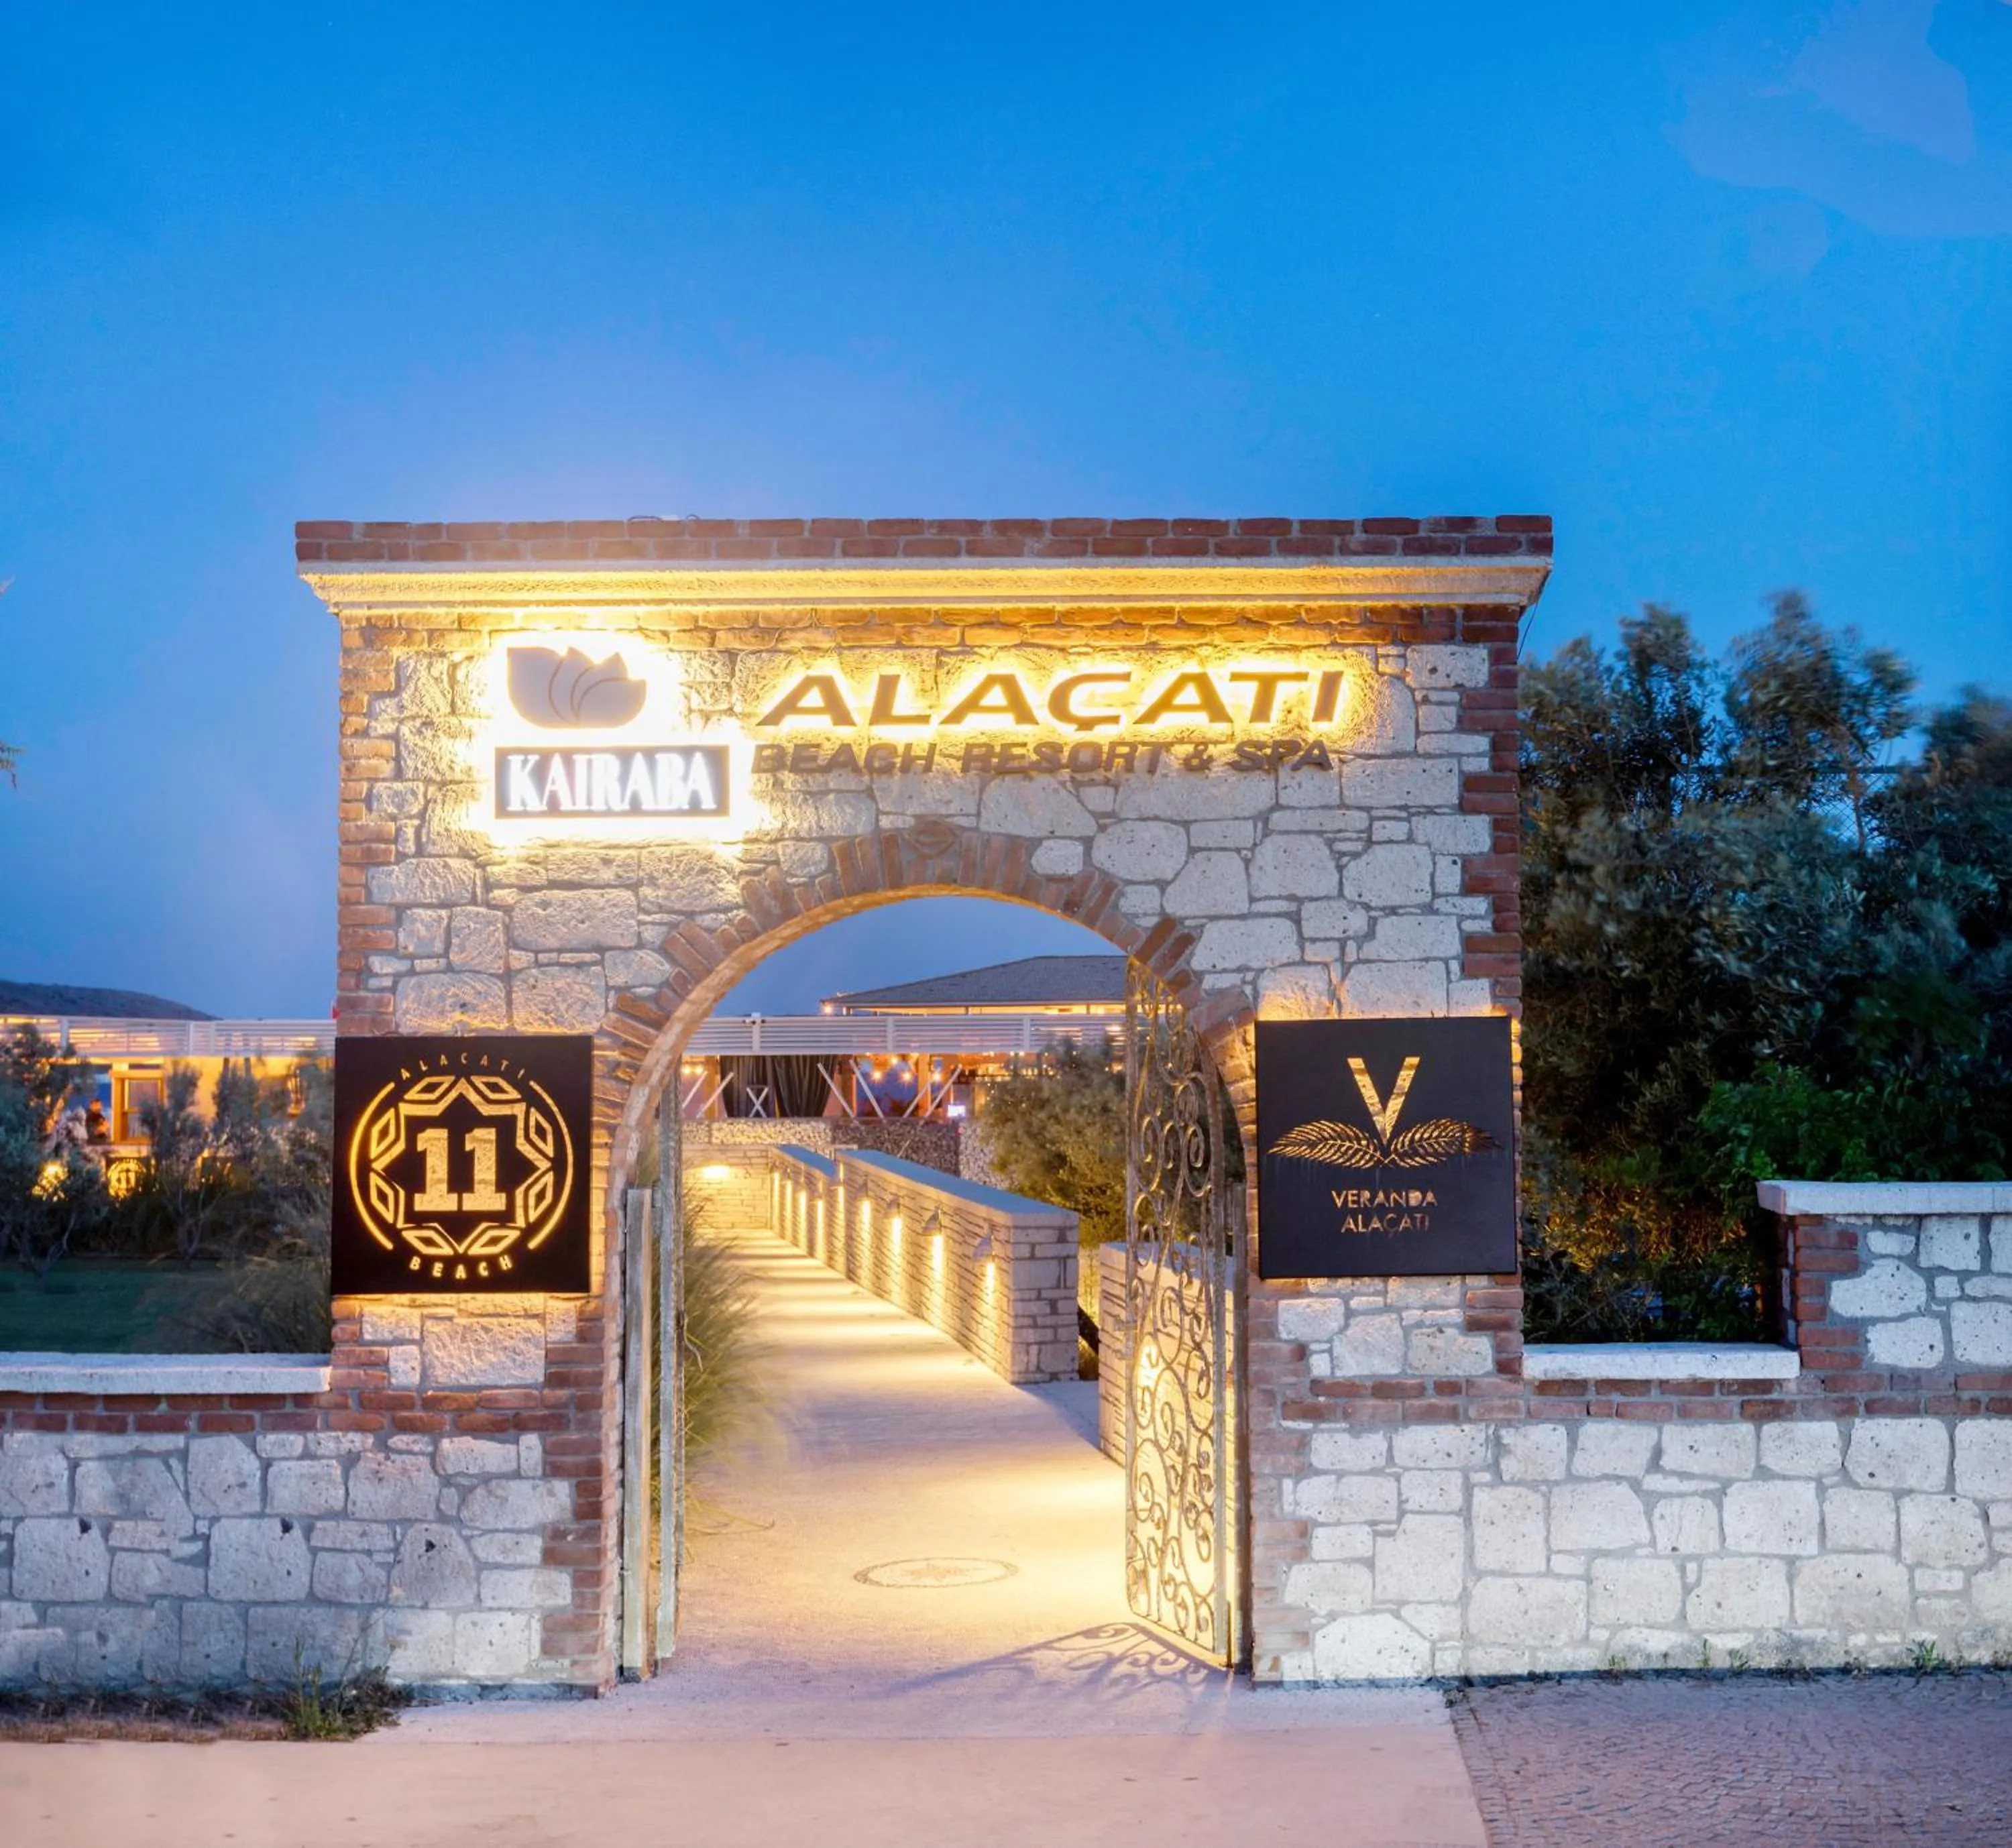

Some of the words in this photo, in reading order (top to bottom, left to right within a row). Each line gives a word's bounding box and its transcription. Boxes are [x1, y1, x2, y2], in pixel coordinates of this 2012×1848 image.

[755, 670, 1344, 732] ALAÇATI
[751, 742, 938, 774] BEACH
[960, 740, 1167, 774] RESORT
[1182, 744, 1214, 772] &
[1230, 740, 1334, 772] SPA
[506, 752, 718, 812] KAIRABA
[400, 1052, 525, 1081] ALACATI
[1347, 1056, 1421, 1146] V
[414, 1128, 507, 1212] 11
[1331, 1188, 1439, 1209] VERANDA
[409, 1255, 514, 1279] BEACH
